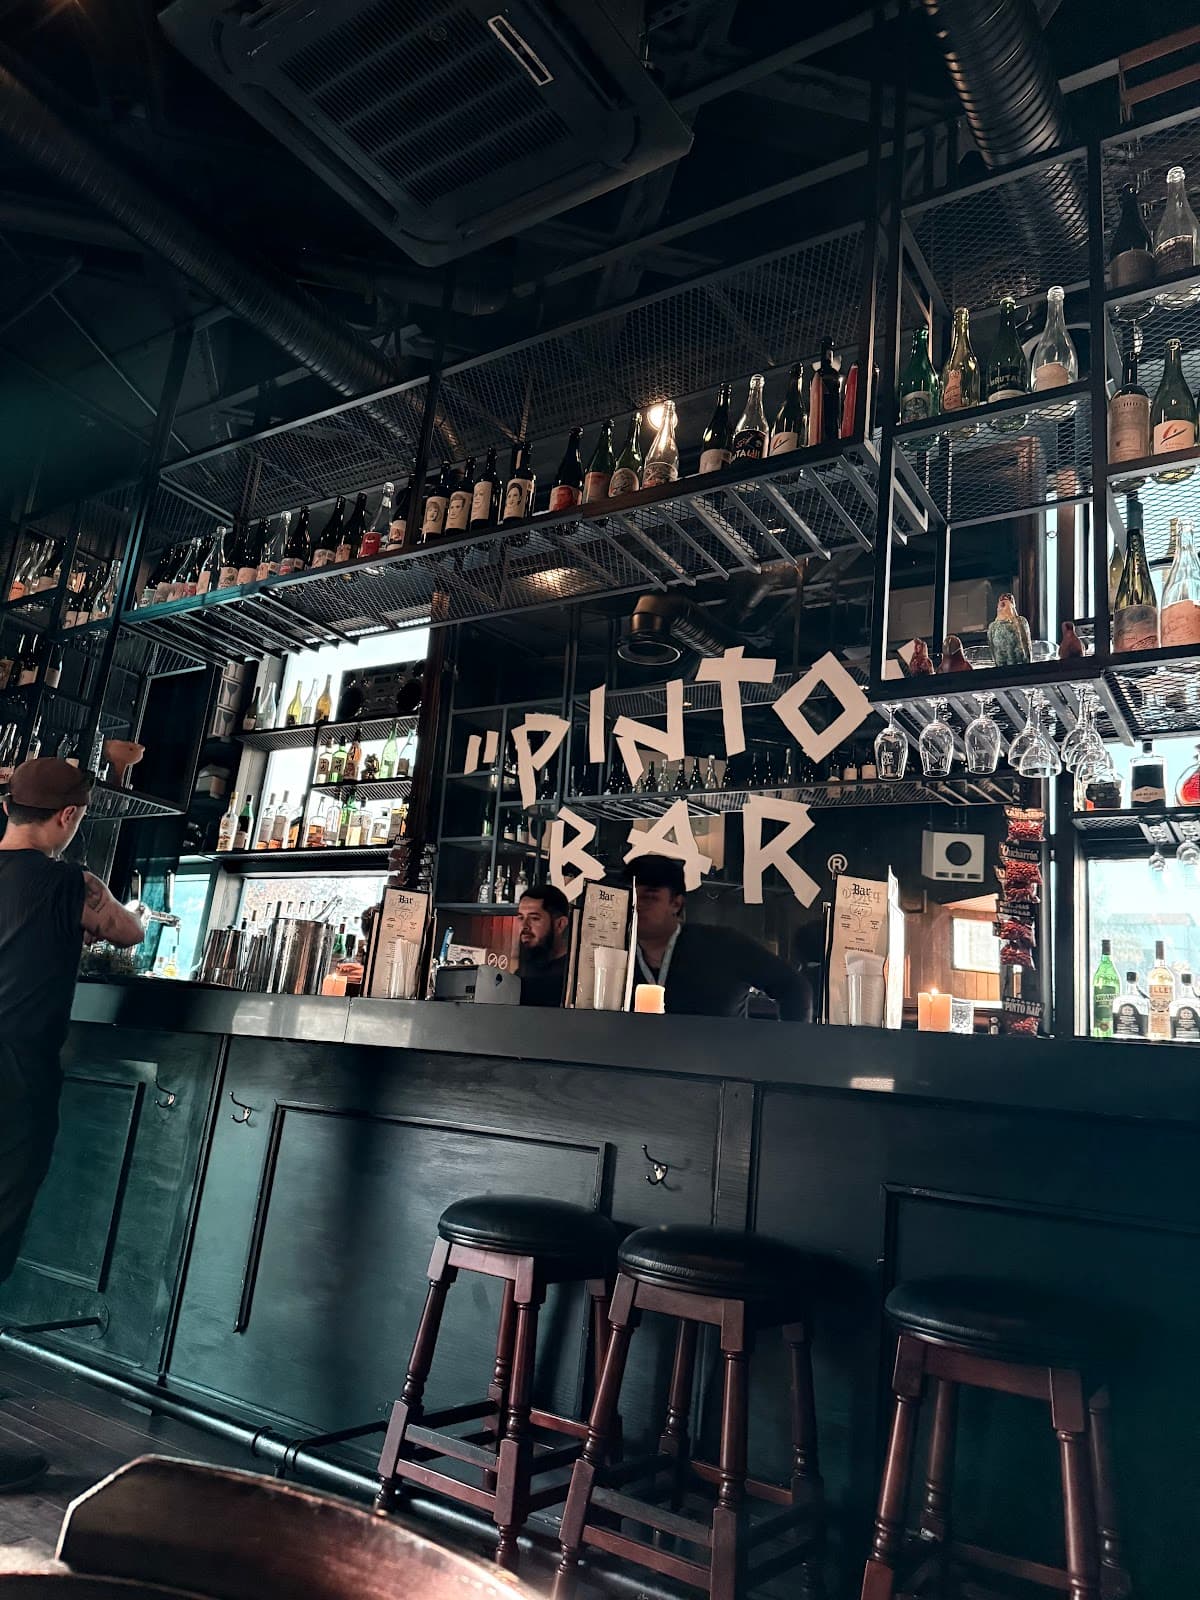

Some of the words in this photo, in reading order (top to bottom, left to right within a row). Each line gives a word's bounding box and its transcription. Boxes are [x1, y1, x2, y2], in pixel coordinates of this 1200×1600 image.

[549, 794, 821, 909] BAR
[598, 889, 615, 901] Bar
[852, 883, 872, 896] Bar
[398, 894, 413, 904] Bar
